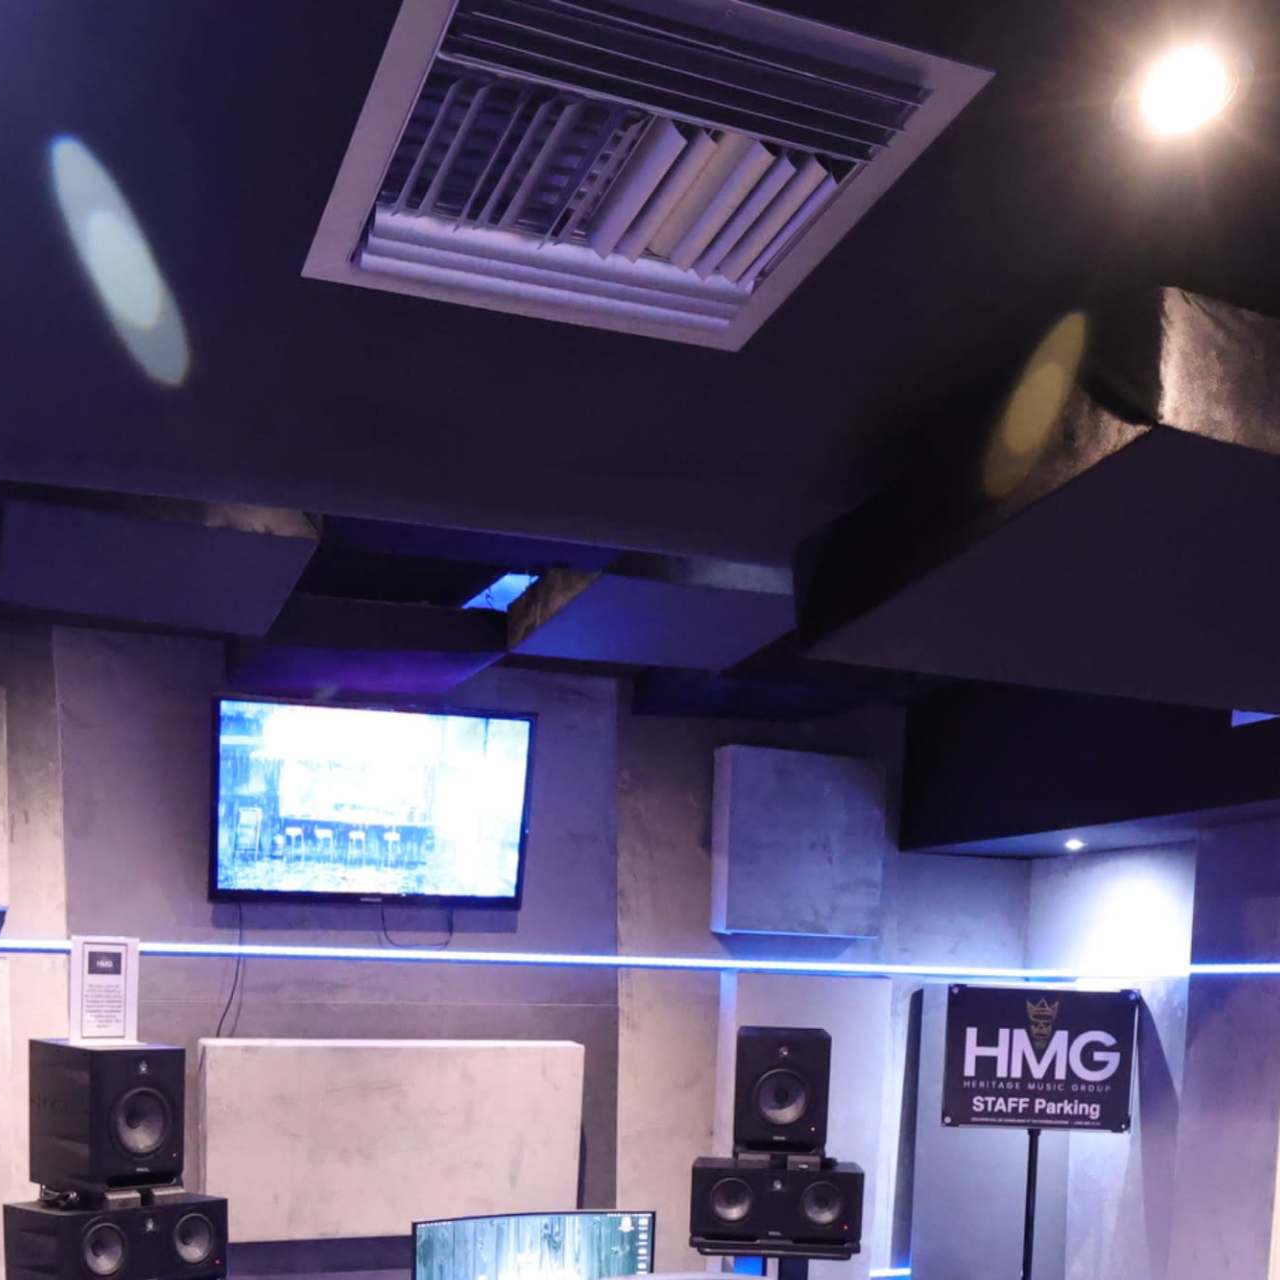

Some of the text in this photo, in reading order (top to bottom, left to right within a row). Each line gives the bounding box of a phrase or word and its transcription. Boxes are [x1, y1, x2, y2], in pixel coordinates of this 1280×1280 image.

[963, 1027, 1120, 1082] HMG
[963, 1080, 1111, 1093] HERITAGE MUSIC GROUP
[972, 1096, 1100, 1118] STAFF Parking
